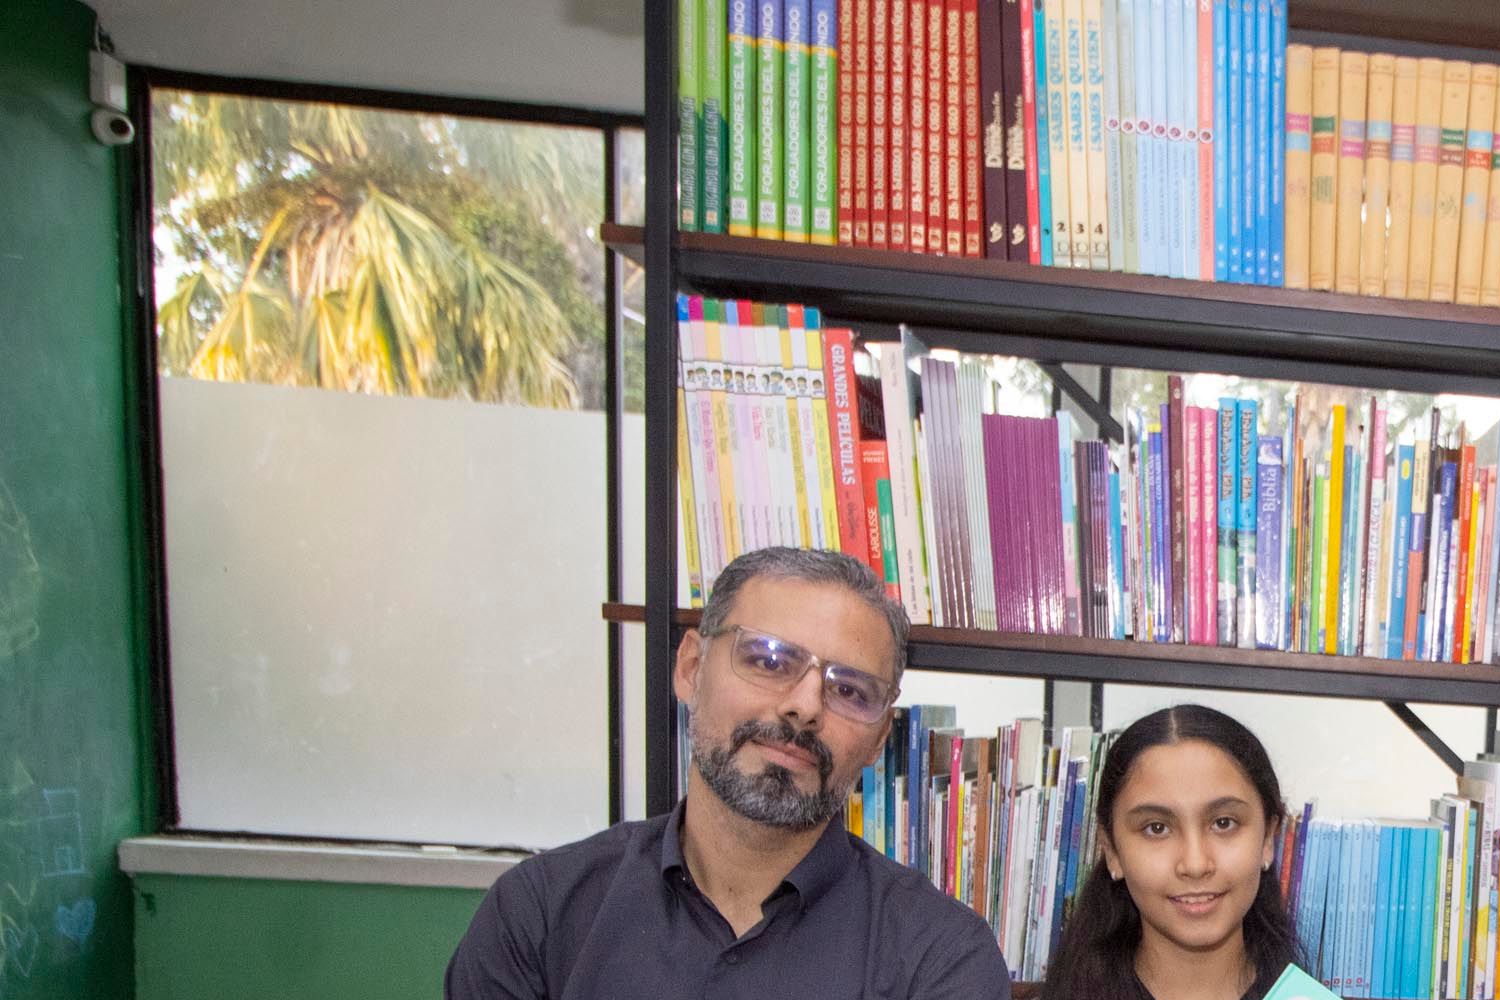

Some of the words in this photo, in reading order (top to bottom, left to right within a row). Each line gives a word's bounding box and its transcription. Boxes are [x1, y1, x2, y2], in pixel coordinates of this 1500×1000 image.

[733, 2, 745, 57] MUNDO
[762, 4, 773, 61] MUNDO
[789, 8, 800, 65] MUNDO
[817, 12, 828, 68] MUNDO
[733, 62, 745, 90] DEL
[762, 64, 773, 94] DEL
[789, 68, 800, 97] DEL
[817, 71, 828, 101] DEL
[733, 92, 745, 191] FORJADORES
[762, 96, 773, 194] FORJADORES
[789, 100, 800, 198] FORJADORES
[817, 103, 828, 201] FORJADORES
[831, 344, 849, 409] GRANDES
[837, 412, 855, 486] PELÍCULAS
[1262, 468, 1277, 512] Biblia
[867, 506, 881, 559] LAROUSSE
